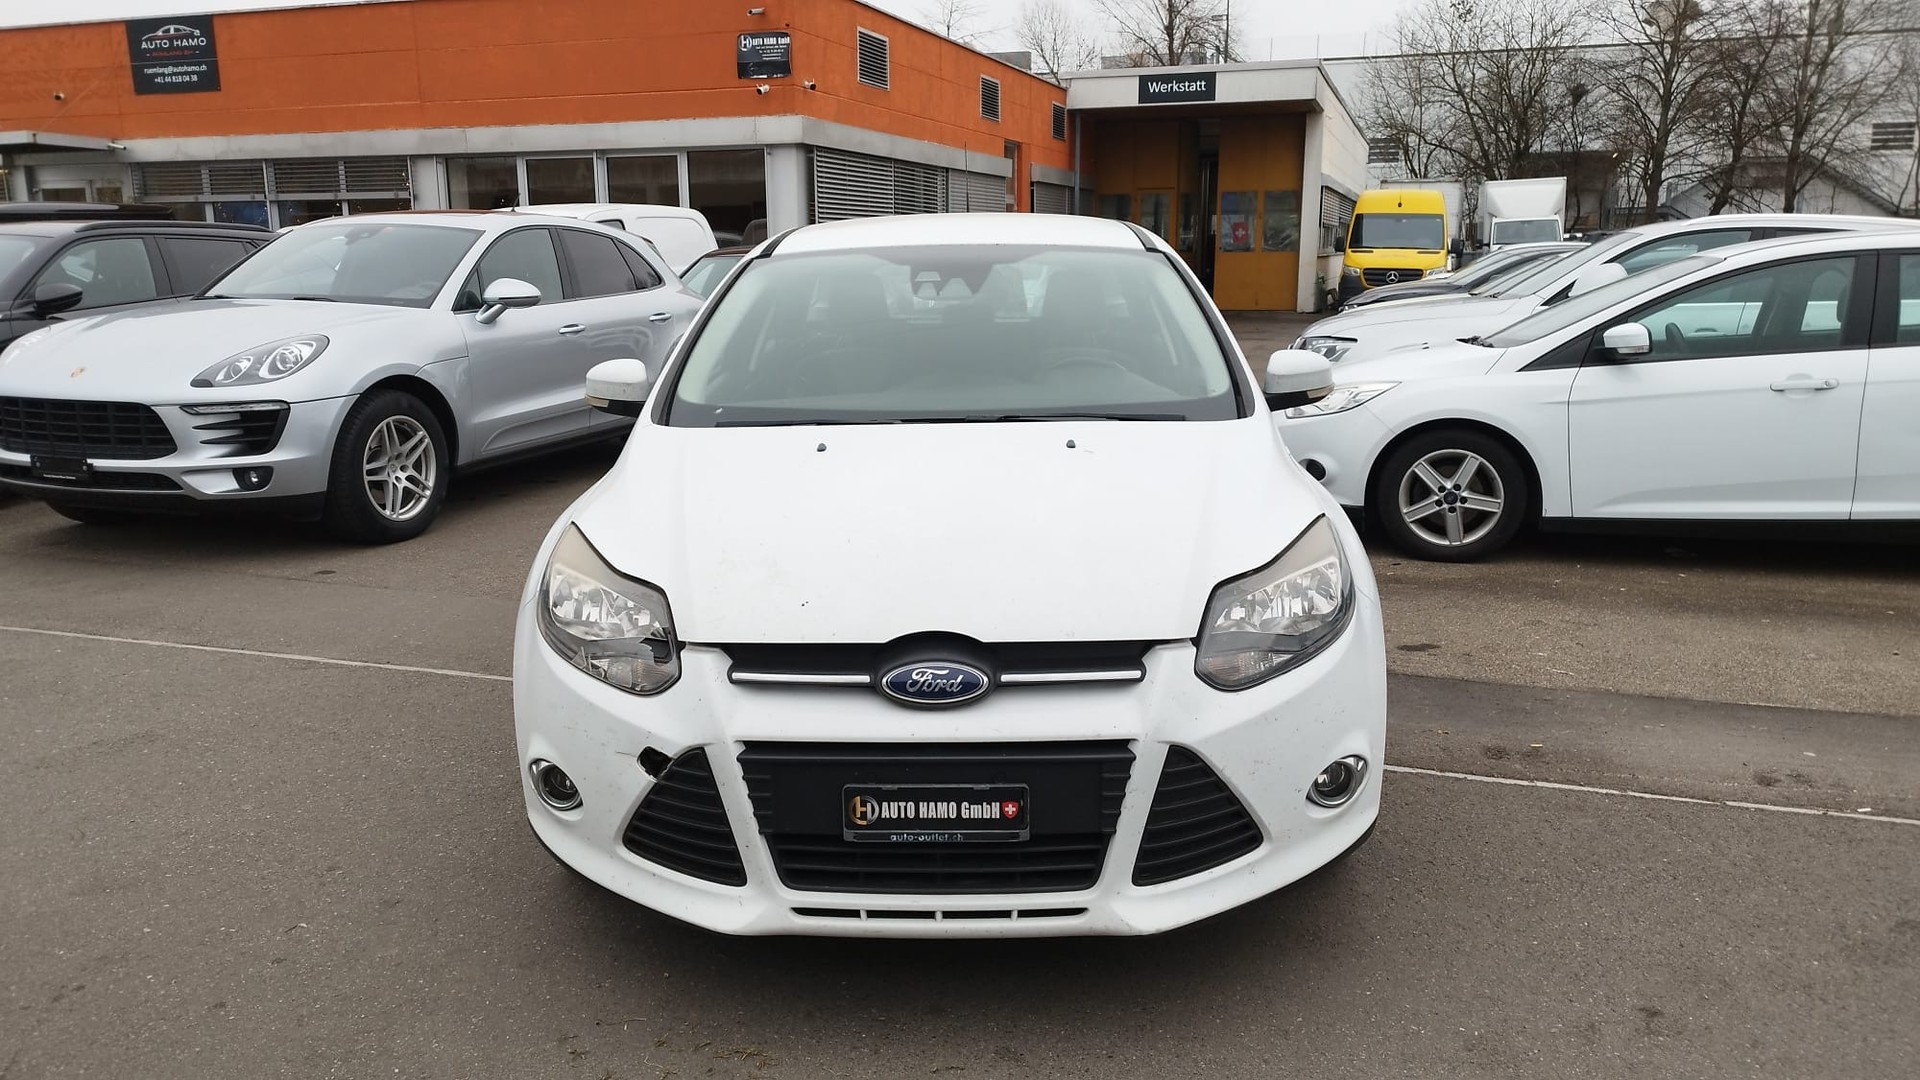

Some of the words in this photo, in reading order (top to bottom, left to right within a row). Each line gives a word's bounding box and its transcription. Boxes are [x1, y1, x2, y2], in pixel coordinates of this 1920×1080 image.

[141, 40, 169, 49] AUTO
[173, 37, 207, 47] HAMO
[1148, 80, 1206, 93] Werkstatt
[906, 668, 964, 692] Ford
[881, 802, 915, 819] AUTO
[919, 802, 957, 819] HAMO
[961, 802, 1000, 819] GmbH
[890, 833, 964, 842] auto-outlet.ch
